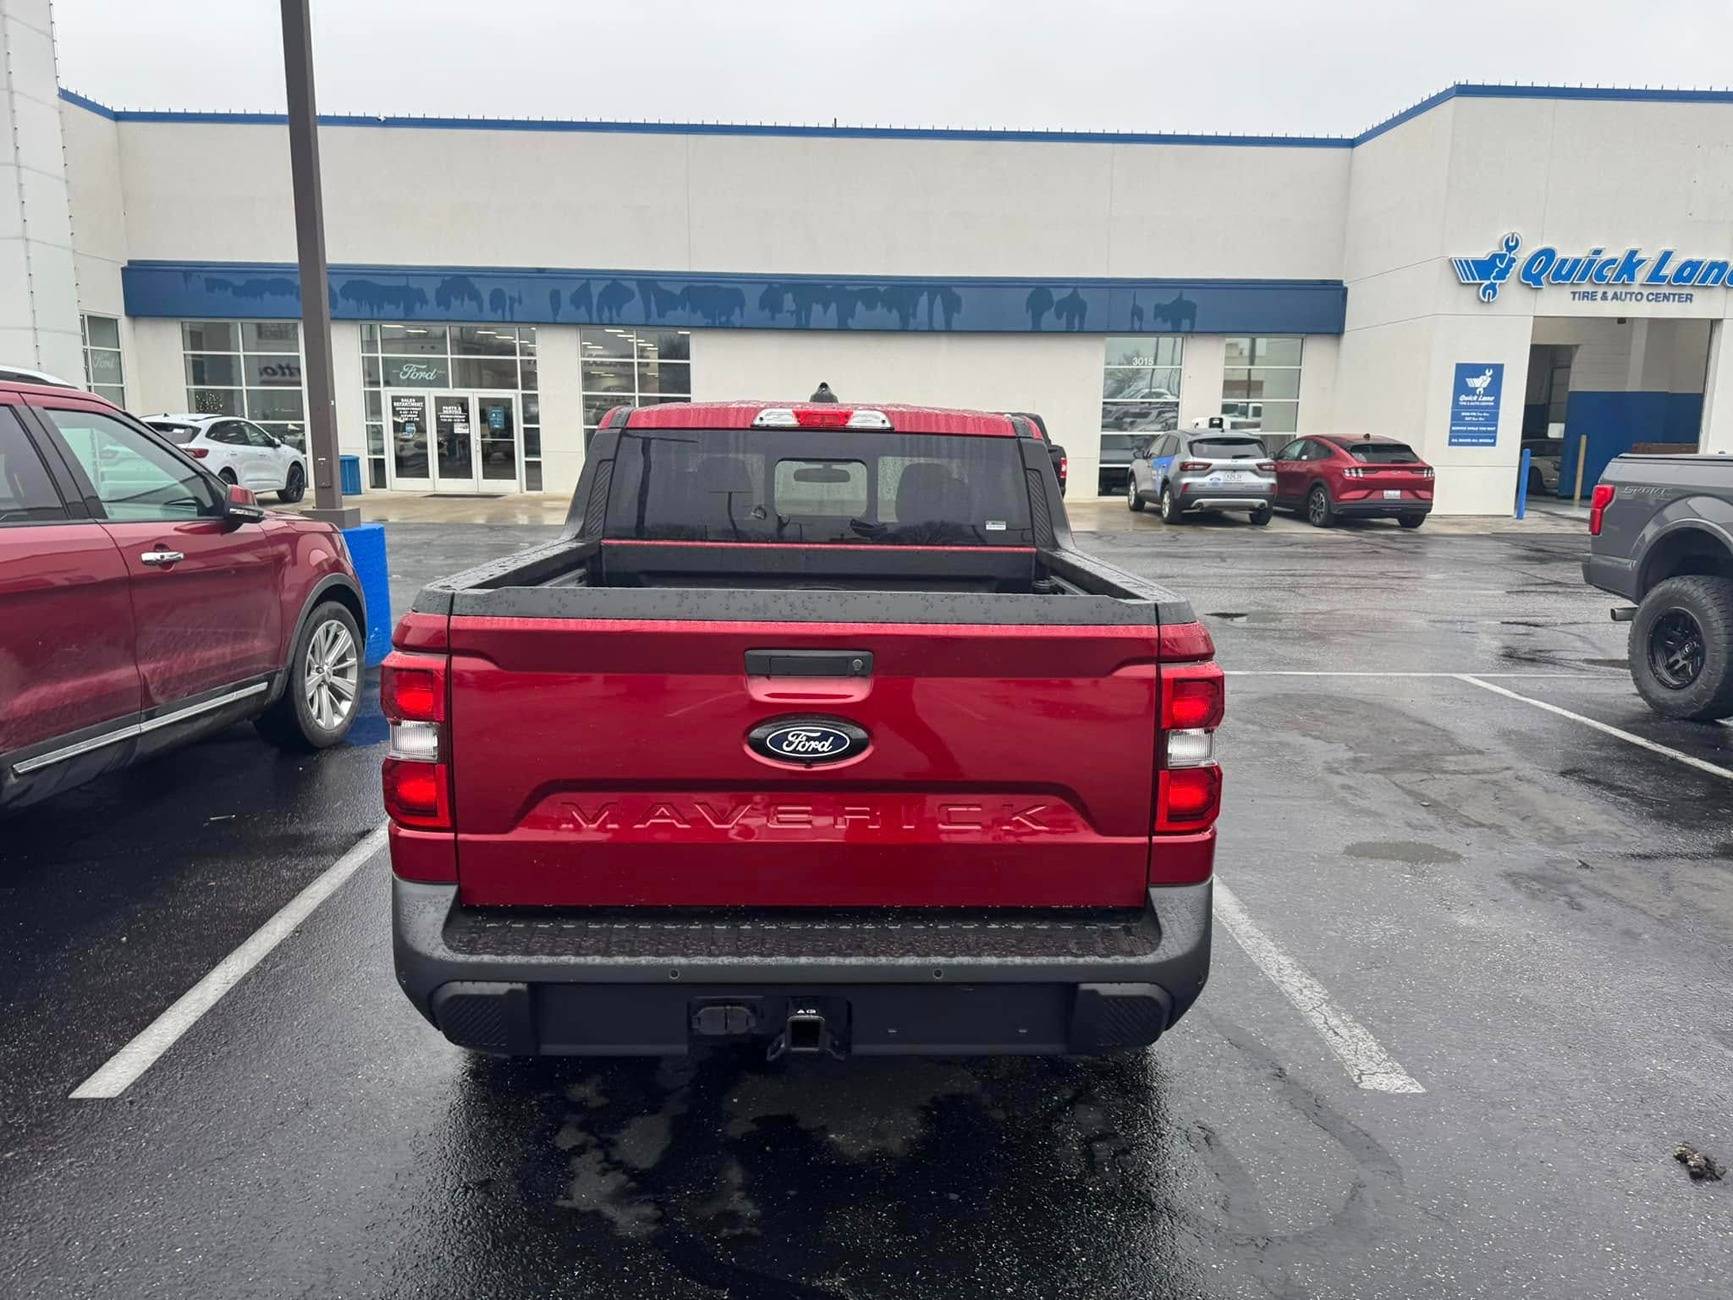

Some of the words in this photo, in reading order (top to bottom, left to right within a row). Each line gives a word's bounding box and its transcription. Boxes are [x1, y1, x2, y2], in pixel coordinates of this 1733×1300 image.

[1520, 246, 1649, 289] Quick
[1570, 291, 1599, 302] TIRE
[1600, 291, 1609, 301] &
[1611, 291, 1644, 302] AUTO
[1646, 292, 1694, 303] CENTER
[1132, 356, 1154, 366] 3015
[400, 363, 437, 380] Ford
[782, 730, 834, 752] Ford
[560, 800, 1050, 830] MAVERICK
